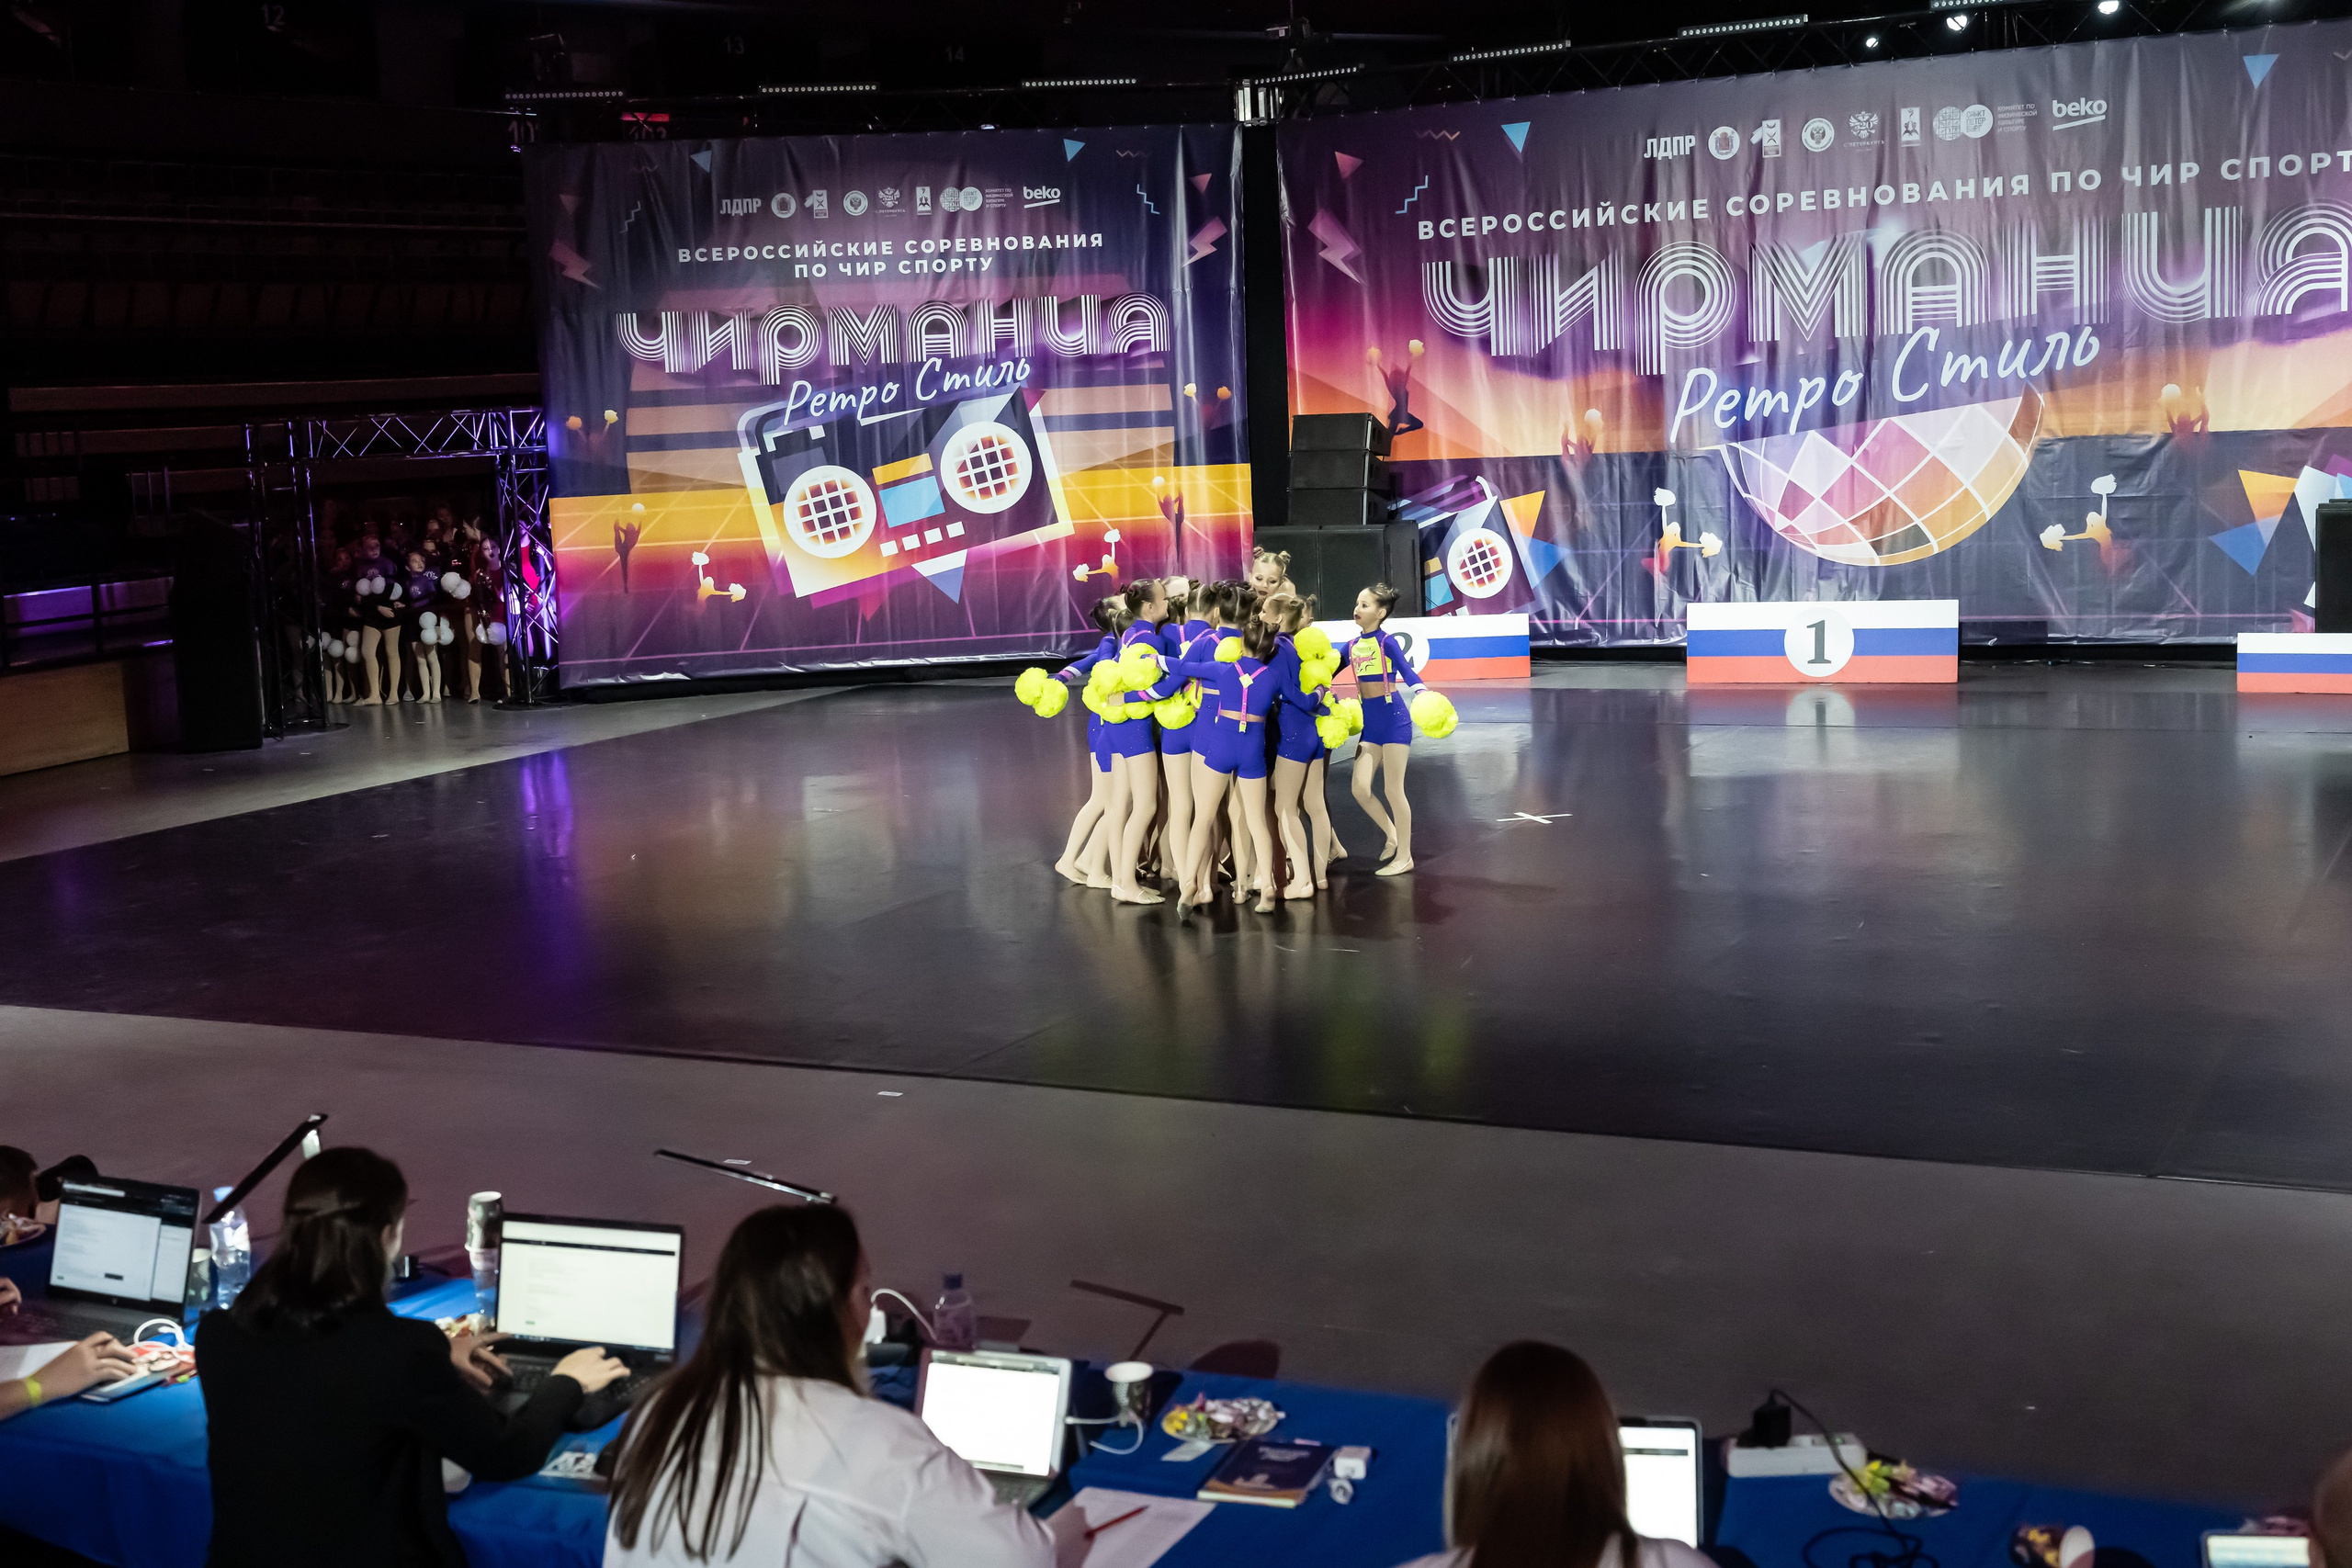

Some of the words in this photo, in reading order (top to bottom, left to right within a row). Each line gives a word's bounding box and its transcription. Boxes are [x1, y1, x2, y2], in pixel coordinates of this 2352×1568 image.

[2052, 96, 2108, 118] beko
[1643, 134, 1696, 161] ЛДПР
[719, 197, 762, 217] ЛДПР
[1023, 186, 1061, 201] beko
[1418, 198, 1709, 240] ВСЕРОССИЙСКИЕ
[1725, 175, 2029, 217] СОРЕВНОВАНИЯ
[2051, 169, 2102, 193] ПО
[2121, 162, 2200, 186] ЧИР
[678, 240, 893, 263] ВСЕРОССИЙСКИЕ
[904, 232, 1103, 254] СОРЕВНОВАНИЯ
[794, 263, 827, 278] ПО
[838, 261, 887, 276] ЧИР
[898, 256, 993, 275] СПОРТУ
[783, 379, 900, 426] Ретро
[916, 356, 1031, 401] Стиль
[1669, 367, 1865, 444] Ретро
[1892, 326, 2100, 402] Стиль
[1806, 619, 1832, 664] 1
